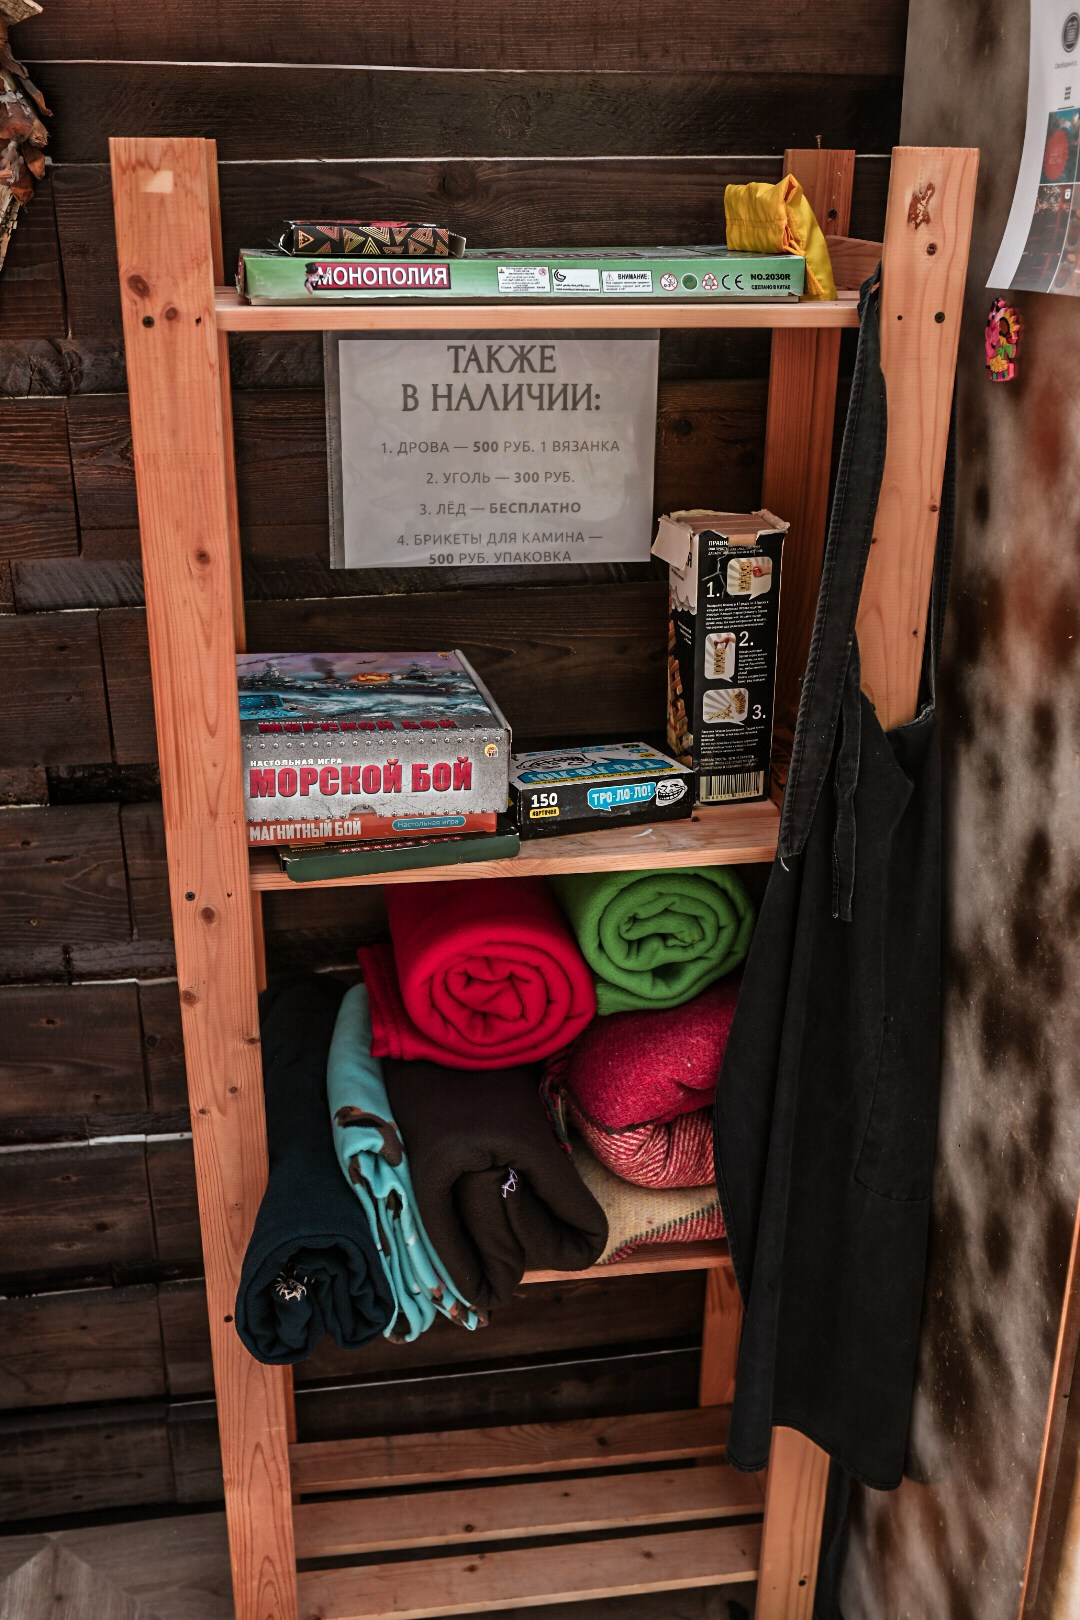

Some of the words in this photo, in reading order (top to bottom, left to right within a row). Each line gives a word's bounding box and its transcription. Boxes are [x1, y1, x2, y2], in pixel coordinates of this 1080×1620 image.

[317, 266, 448, 285] МОНОПОЛИЯ
[750, 273, 791, 281] NO.2030R
[447, 345, 556, 374] ТАКЖЕ
[402, 383, 419, 412] В
[431, 383, 601, 412] НАЛИЧИИ:
[381, 442, 392, 454] 1.
[397, 442, 449, 455] ДРОВА
[472, 441, 499, 453] 500
[503, 441, 535, 454] РУБ.
[540, 441, 547, 453] 1
[552, 441, 620, 452] ВЯЗАНКА
[426, 472, 438, 484] 2.
[443, 472, 490, 484] УГОЛЬ
[513, 472, 540, 484] 300
[544, 472, 575, 484] РУБ.
[419, 503, 432, 515] 3.
[436, 502, 467, 517] ЛЁД
[489, 502, 582, 515] БЕСПЛАТНО
[397, 535, 409, 547] 4.
[414, 534, 482, 546] БРИКЕТЫ
[486, 533, 517, 547] ДЛЯ
[522, 532, 585, 544] КАМИНА
[428, 553, 454, 565] 500
[459, 552, 490, 564] РУБ.
[494, 551, 572, 563] УПАКОВКА
[706, 582, 720, 597] 1.
[738, 631, 754, 647] 2.
[752, 704, 766, 719] 3.
[258, 720, 395, 733] МОРСКОЙ
[401, 718, 458, 729] БОЙ
[250, 759, 314, 767] НАСТОЛЬНАЯ
[317, 758, 343, 766] ИГРА
[250, 759, 403, 798] МОРСКОЙ
[411, 757, 472, 792] БОЙ
[531, 792, 558, 807] 150
[591, 787, 652, 805] ТРО-ЛО-ЛО!
[250, 819, 332, 841] МАГНИТНЫЙ
[334, 817, 361, 836] БОЙ
[441, 820, 459, 828] игра
